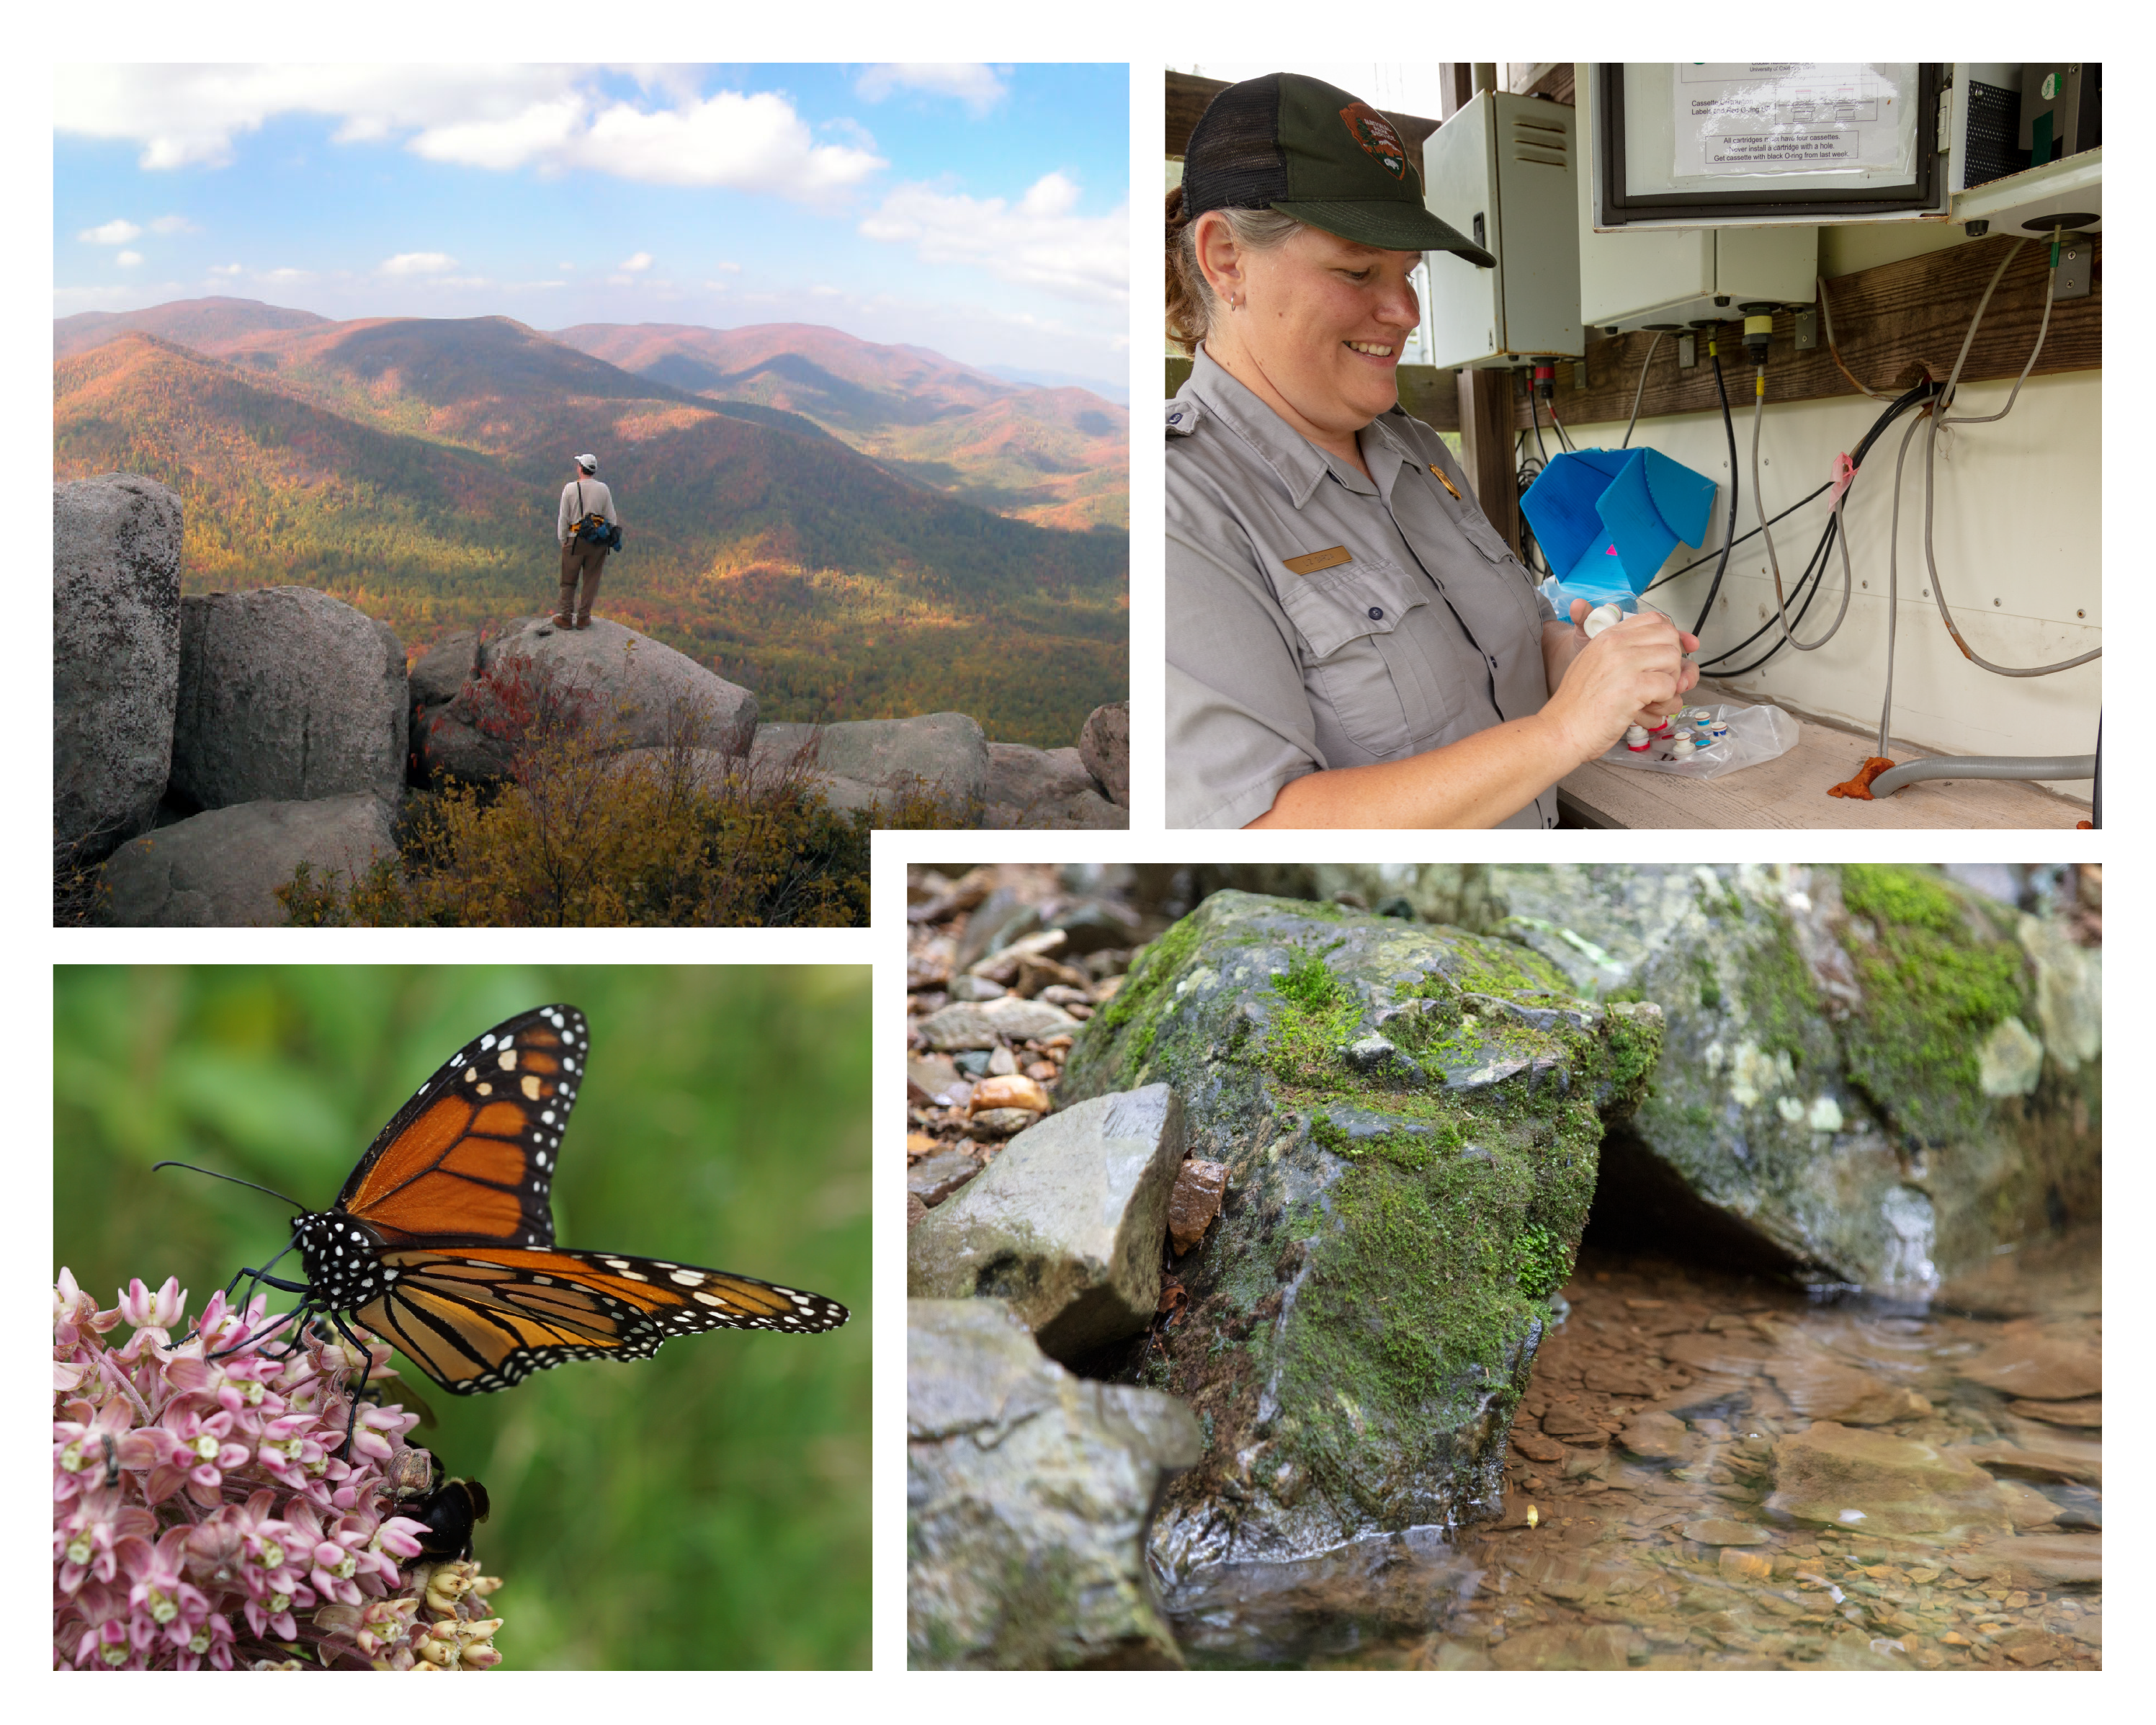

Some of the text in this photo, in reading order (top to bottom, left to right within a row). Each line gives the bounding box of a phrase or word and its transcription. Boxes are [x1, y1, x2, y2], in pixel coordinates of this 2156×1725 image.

[1364, 118, 1392, 132] NATIONAL
[1373, 126, 1388, 135] PARK
[1370, 130, 1396, 141] SERVICE
[1488, 329, 1494, 351] A
